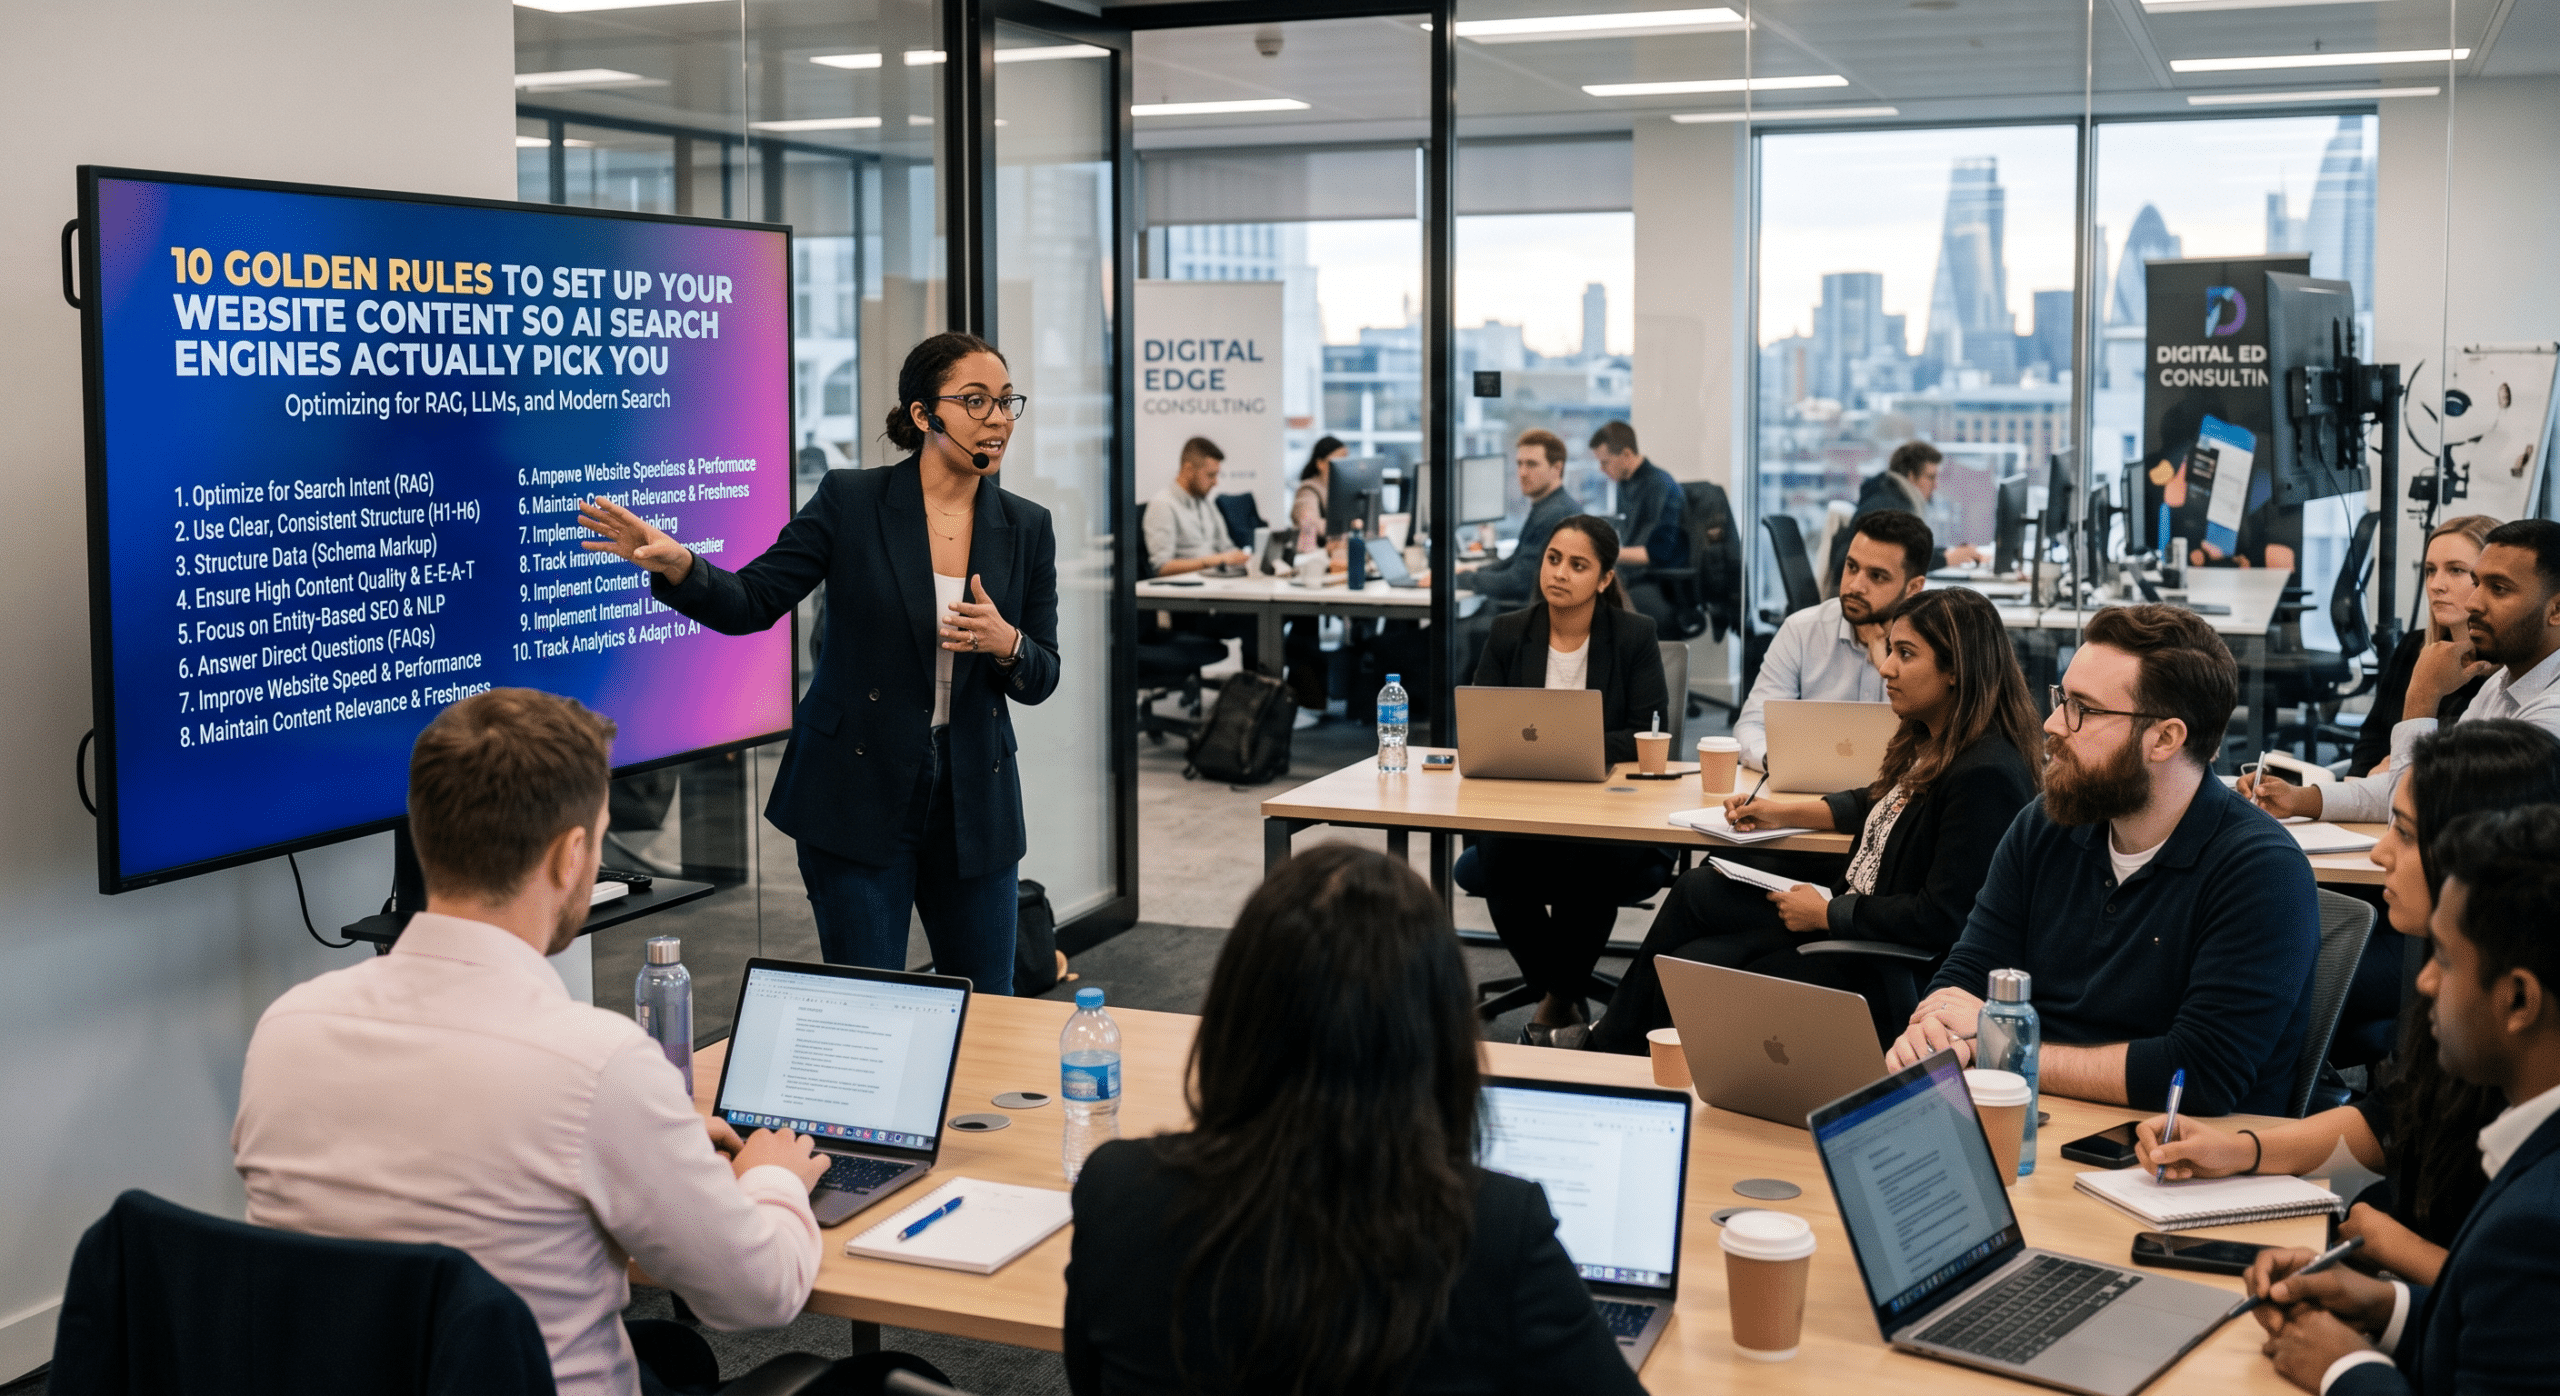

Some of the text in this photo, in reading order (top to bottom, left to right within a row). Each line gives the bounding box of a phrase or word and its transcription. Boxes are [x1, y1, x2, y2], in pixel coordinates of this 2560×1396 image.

[171, 247, 733, 304] 10 GOLDEN RULES TO SET UP YOUR
[173, 294, 719, 339] WEBSITE CONTENT SO AI SEARCH
[176, 340, 668, 376] ENGINES ACTUALLY PICK YOU
[1144, 339, 1264, 362] DIGITAL
[2156, 345, 2268, 364] DIGITAL ED
[1145, 369, 1226, 391] EDGE
[2160, 368, 2269, 387] CONSULTIN
[286, 388, 670, 421] Optimizing for RAG, LLMs, and Modern Search
[1143, 398, 1266, 415] CONSULTING
[518, 468, 530, 486] 6.
[584, 461, 631, 482] Website
[687, 458, 697, 476] &
[175, 472, 433, 511] 1. Optimize for Search Intent (RAG)
[518, 497, 530, 515] 6.
[586, 490, 630, 509] Ctent
[631, 487, 687, 507] Relevance
[687, 484, 697, 502] &
[697, 481, 751, 501] Freshness
[175, 499, 480, 541] 2. Use Clear, Consistent Structure (H1-H6)
[518, 526, 530, 545] 7.
[176, 533, 436, 576] 3. Structure Data (Schema Markup)
[519, 554, 531, 574] 8.
[532, 550, 567, 572] Track
[177, 561, 474, 609] 4. Ensure High Content Quality & E-E-A-T
[519, 584, 531, 603] 9.
[594, 572, 639, 593] Content
[179, 594, 445, 644] 5. Focus on Entity-Based SEO & NLP
[520, 613, 531, 632] 9.
[534, 605, 597, 633] Implement
[599, 597, 643, 621] Internal
[179, 624, 435, 678] 6. Answer Direct Questions (FAQs)
[512, 642, 532, 662] 10.
[533, 635, 570, 659] Track
[571, 631, 626, 654] Analytics
[627, 626, 637, 645] &
[638, 622, 673, 645] Adapt
[673, 621, 686, 638] to
[179, 654, 481, 713] 7. Improve Website Speed & Performance
[181, 682, 490, 747] 8. Maintain Content Relevance & Freshness
